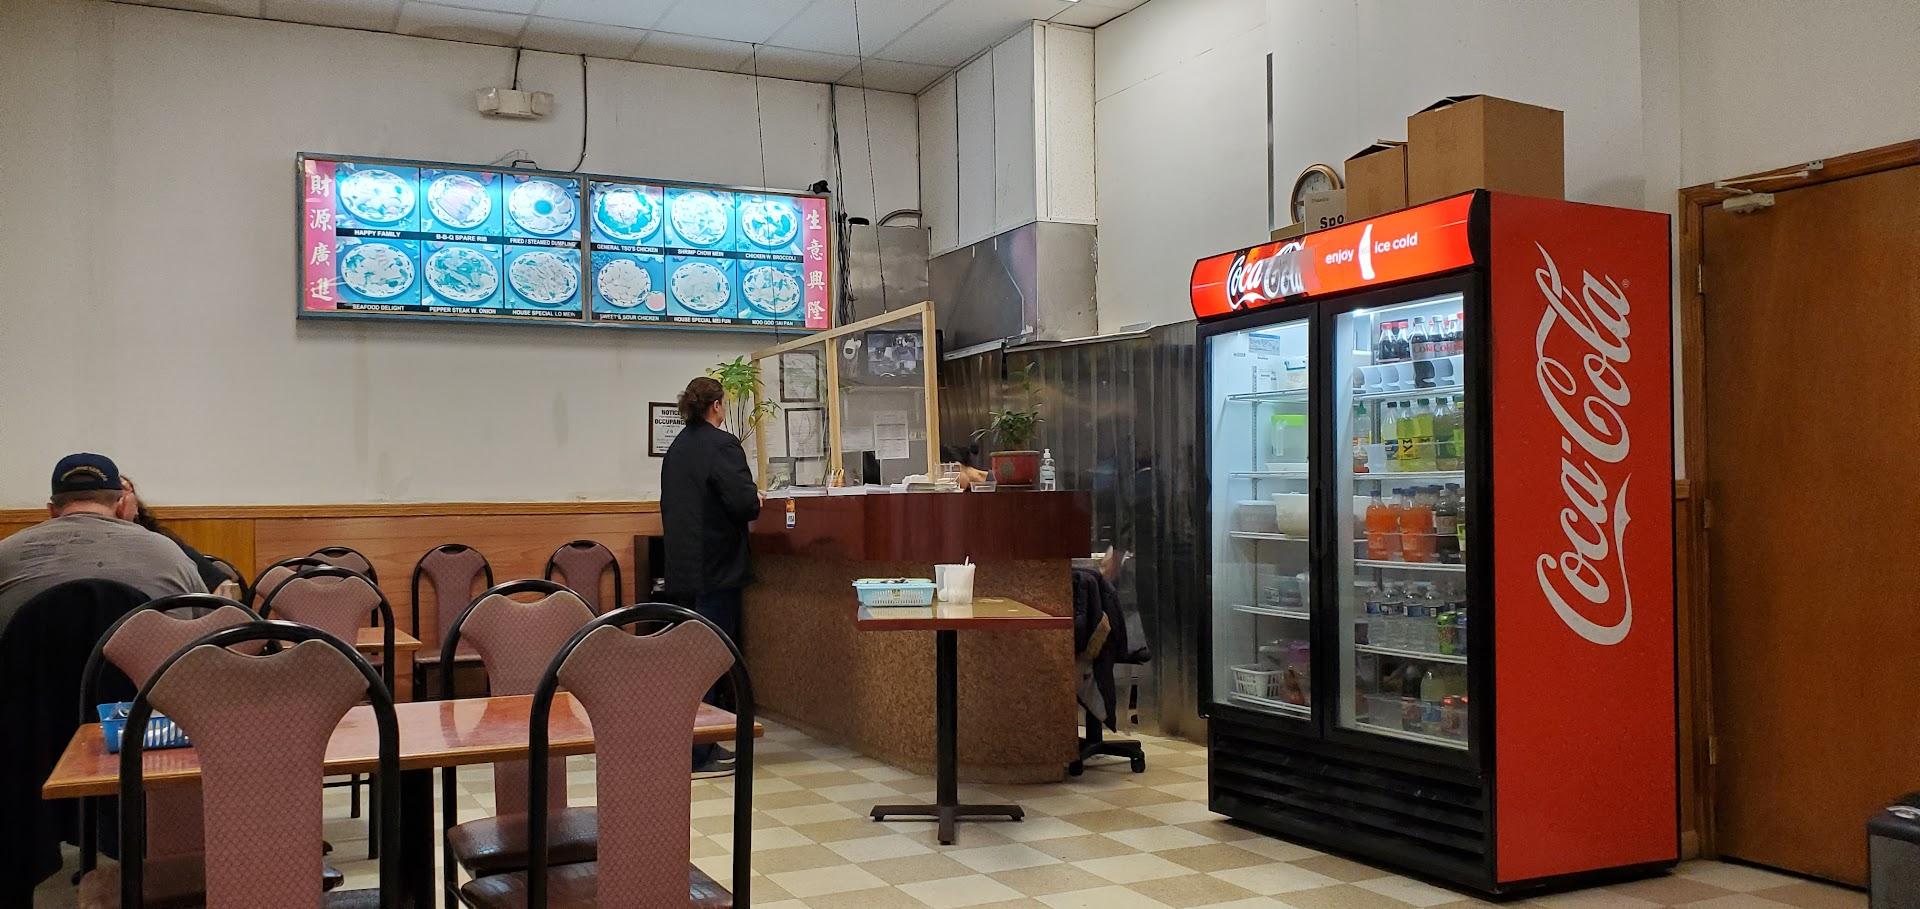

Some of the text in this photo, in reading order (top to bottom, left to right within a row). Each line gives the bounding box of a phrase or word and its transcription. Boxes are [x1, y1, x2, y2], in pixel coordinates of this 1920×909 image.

[309, 173, 333, 302] 財源廣進
[806, 208, 826, 320] 生意興隆
[1325, 231, 1418, 265] enjoy ice cold
[1535, 241, 1632, 645] Coca-Cola
